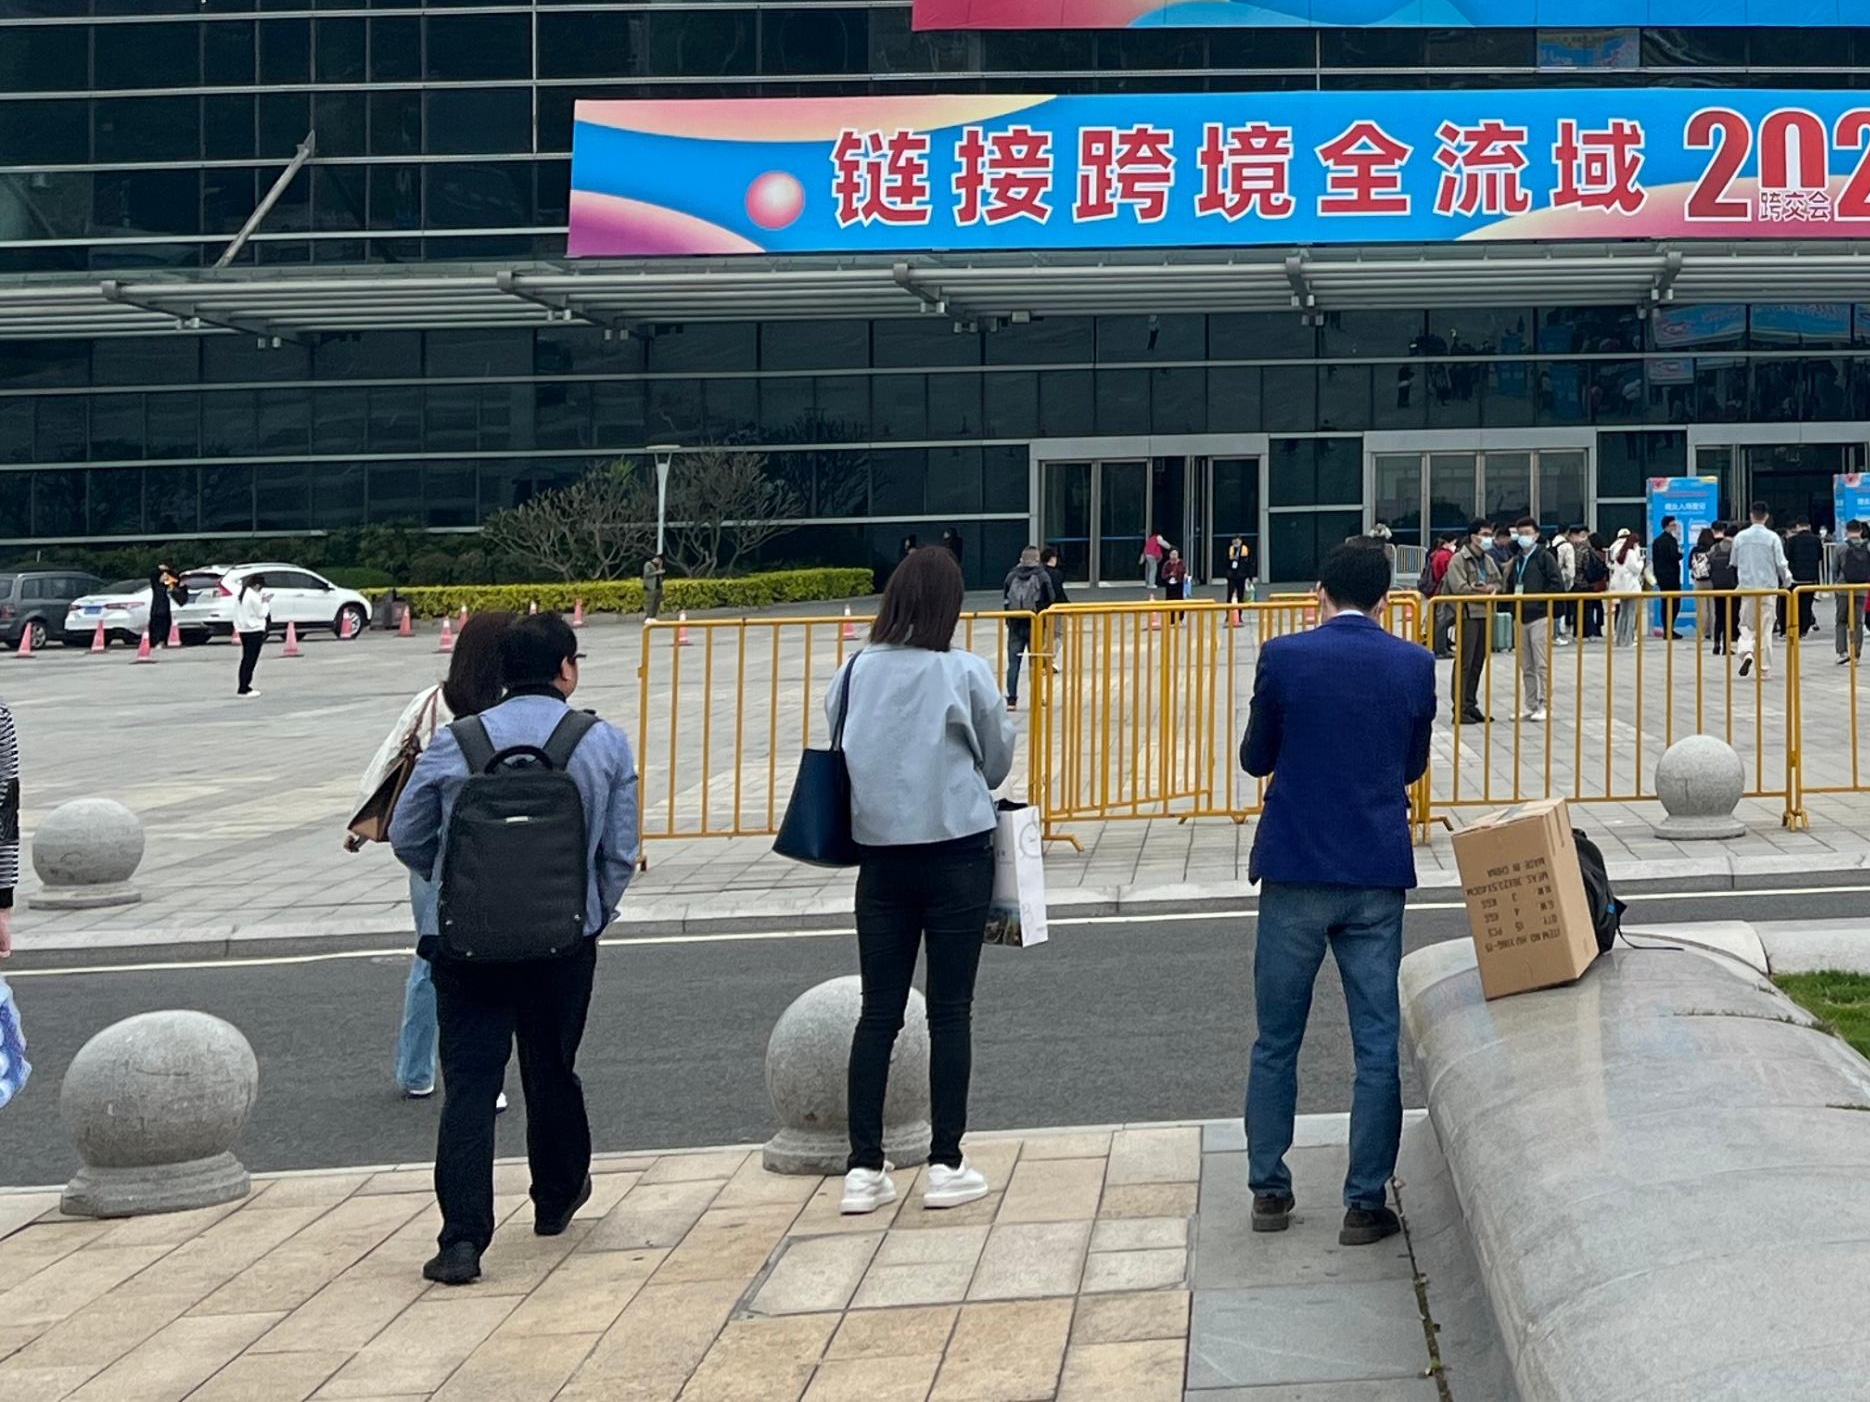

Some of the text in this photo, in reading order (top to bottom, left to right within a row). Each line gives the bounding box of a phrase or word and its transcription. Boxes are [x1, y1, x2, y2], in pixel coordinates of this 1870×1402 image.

[831, 118, 1648, 228] 链接跨境全流域
[1759, 191, 1832, 223] 跨交会
